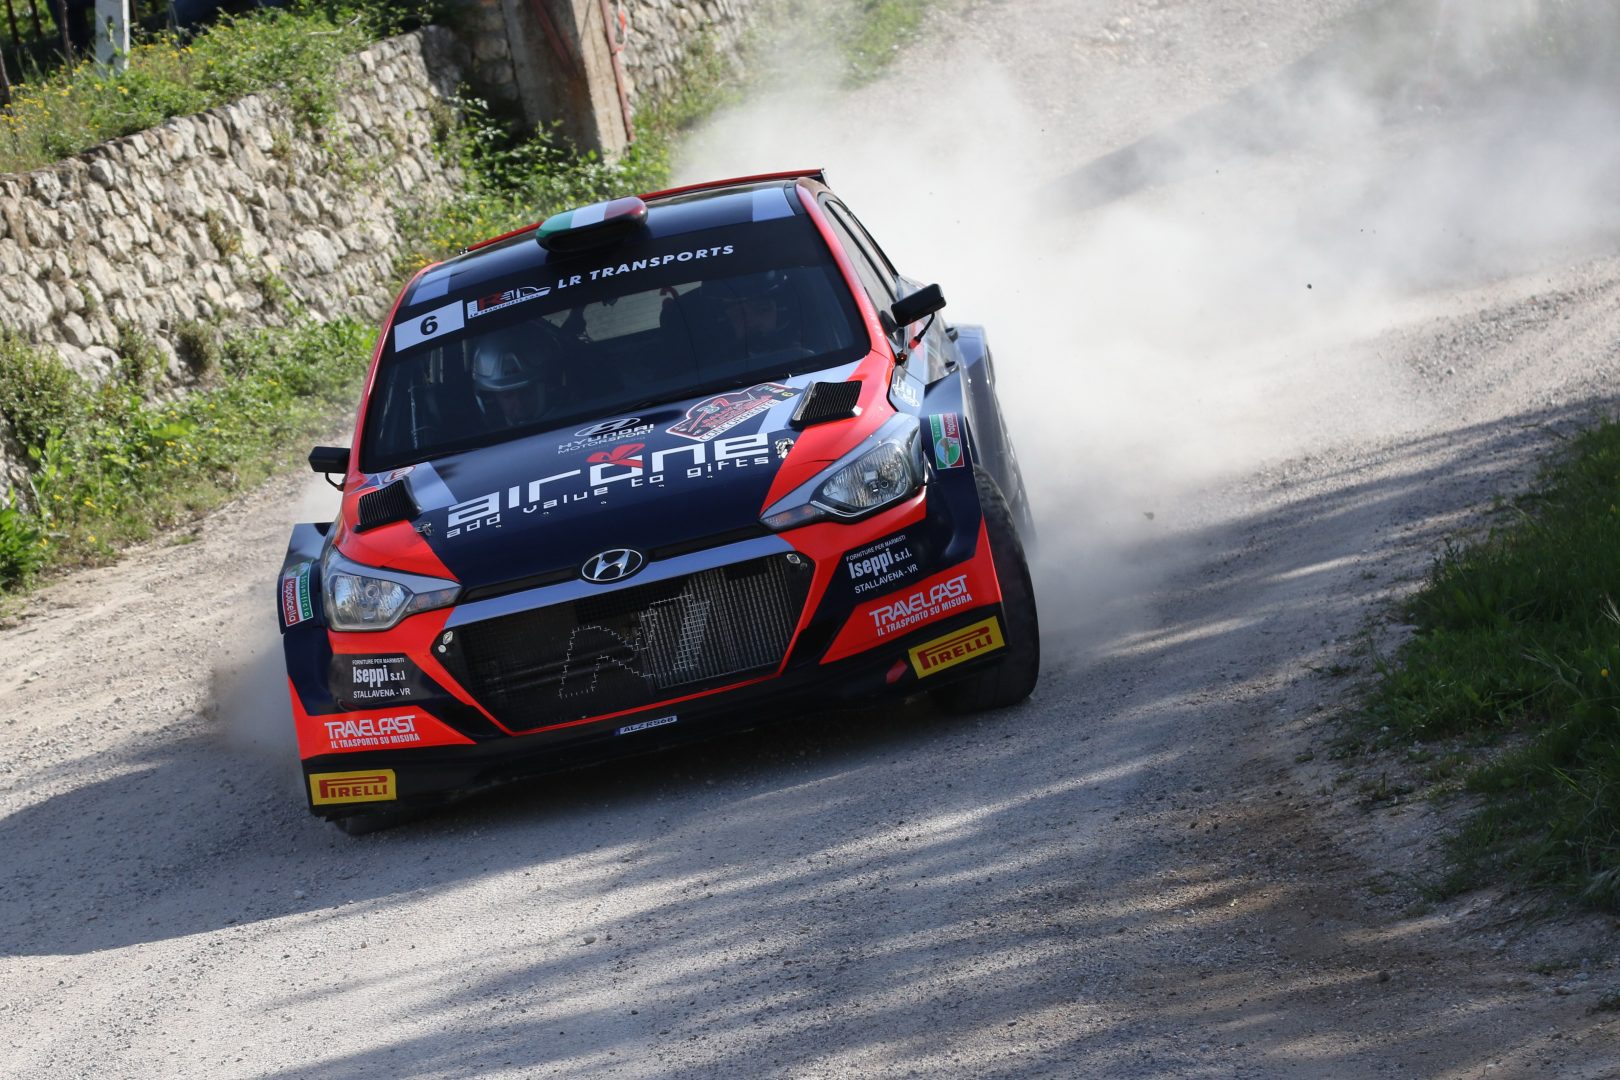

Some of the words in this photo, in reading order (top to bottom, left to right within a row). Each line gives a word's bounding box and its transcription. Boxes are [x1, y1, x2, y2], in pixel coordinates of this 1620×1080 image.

[558, 275, 581, 289] LR
[590, 245, 733, 280] TRANSPORTS
[420, 315, 439, 336] 6
[557, 424, 656, 450] HYUNDAI
[557, 429, 655, 455] MOTORSPORT
[447, 432, 769, 528] airone
[446, 513, 501, 539] add
[523, 486, 609, 515] value
[631, 474, 664, 488] to
[687, 455, 769, 479] gifts
[846, 547, 875, 562] FORNITURE
[875, 543, 885, 551] PER
[848, 548, 894, 579] Iseppi
[894, 548, 912, 562] s.r.l.
[855, 569, 904, 594] STALLAVENA
[907, 564, 918, 573] VR
[869, 575, 968, 627] TRAVELFAST
[877, 628, 886, 637] IL
[886, 611, 929, 632] TRASPORTO
[930, 606, 940, 616] SU
[942, 593, 972, 612] MISURA
[917, 626, 993, 670] PIRELLI
[353, 665, 389, 687] Iseppi
[353, 688, 396, 699] STALLAVENA
[399, 687, 411, 696] VR
[323, 714, 416, 739] TRAVELFAST
[331, 740, 339, 749] IL
[339, 737, 378, 748] TRASPORTO
[380, 736, 390, 745] SU
[391, 733, 420, 744] MISURA
[319, 775, 388, 798] PIRELLI
